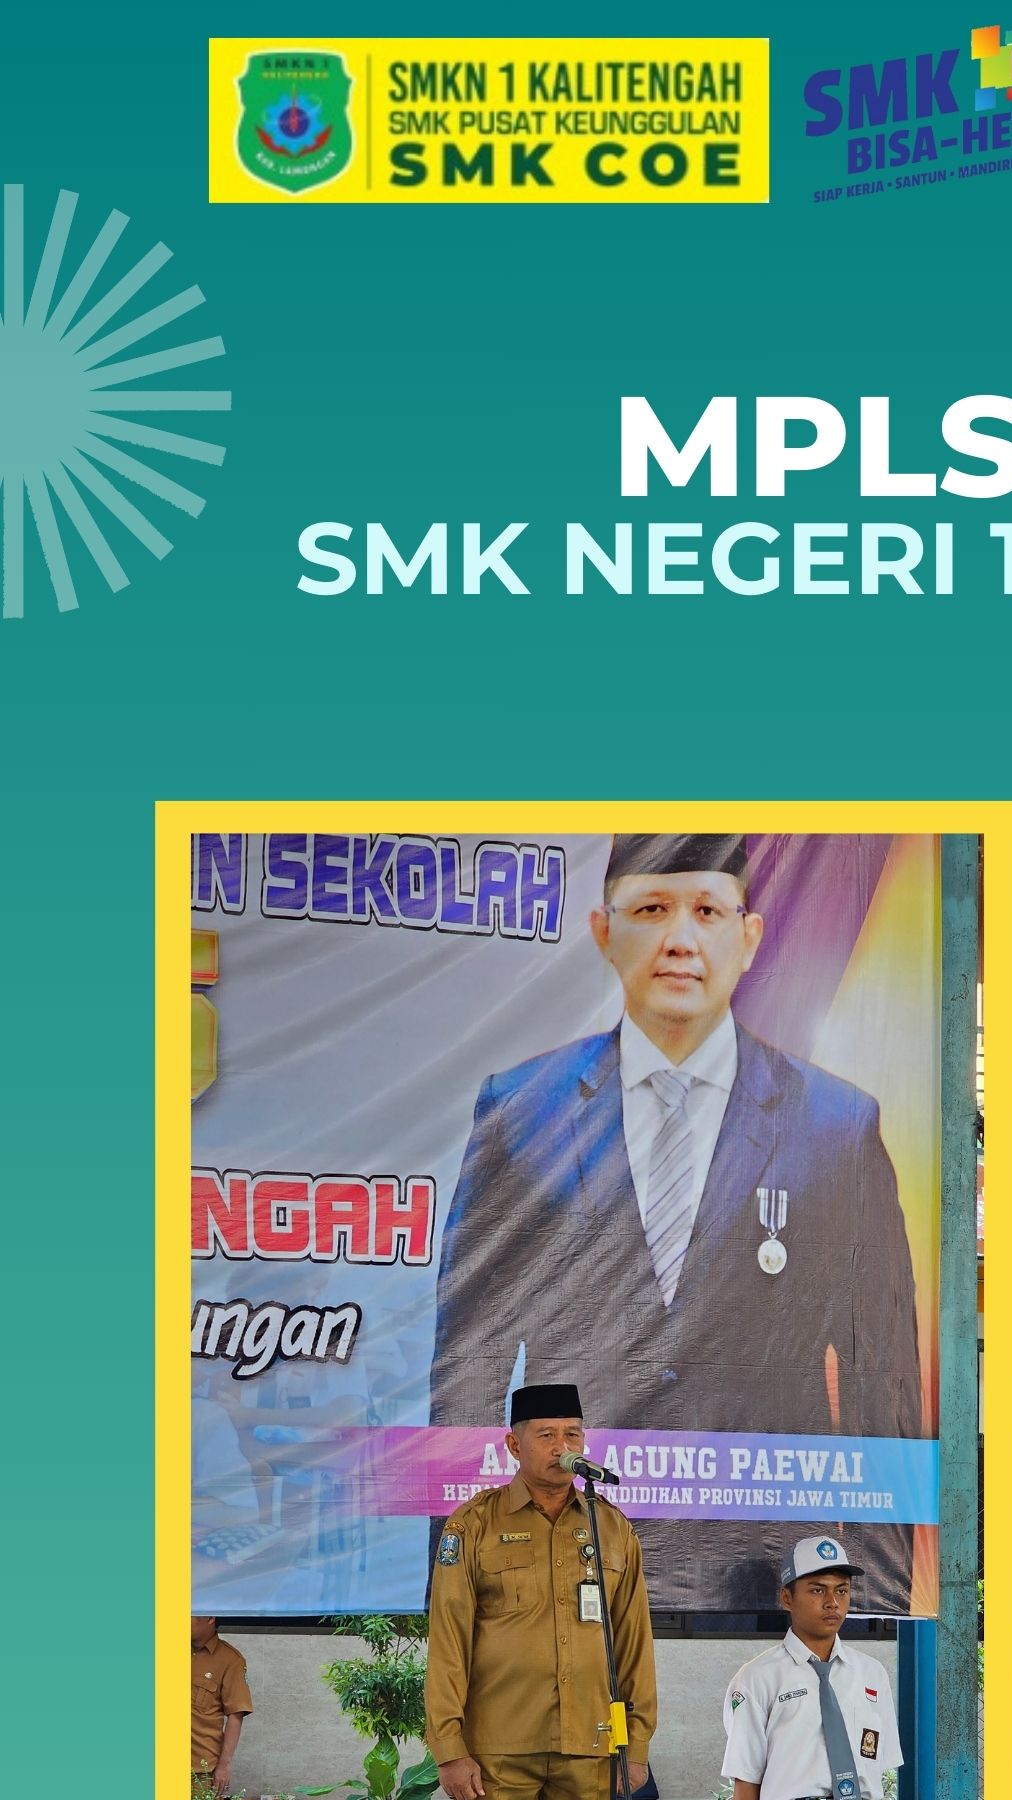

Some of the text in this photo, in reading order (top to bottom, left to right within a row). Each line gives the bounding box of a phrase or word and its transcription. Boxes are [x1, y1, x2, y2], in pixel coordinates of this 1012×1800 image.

[261, 833, 566, 944] SEKOLAH
[191, 1166, 437, 1267] NGAH
[582, 1485, 694, 1505] NDIDIKAN
[698, 1486, 781, 1507] PROVINSI
[787, 1489, 835, 1508] JAWA
[840, 1491, 895, 1509] TIMUR
[603, 1444, 717, 1480] AGUNG
[730, 1448, 864, 1483] PAEWAI
